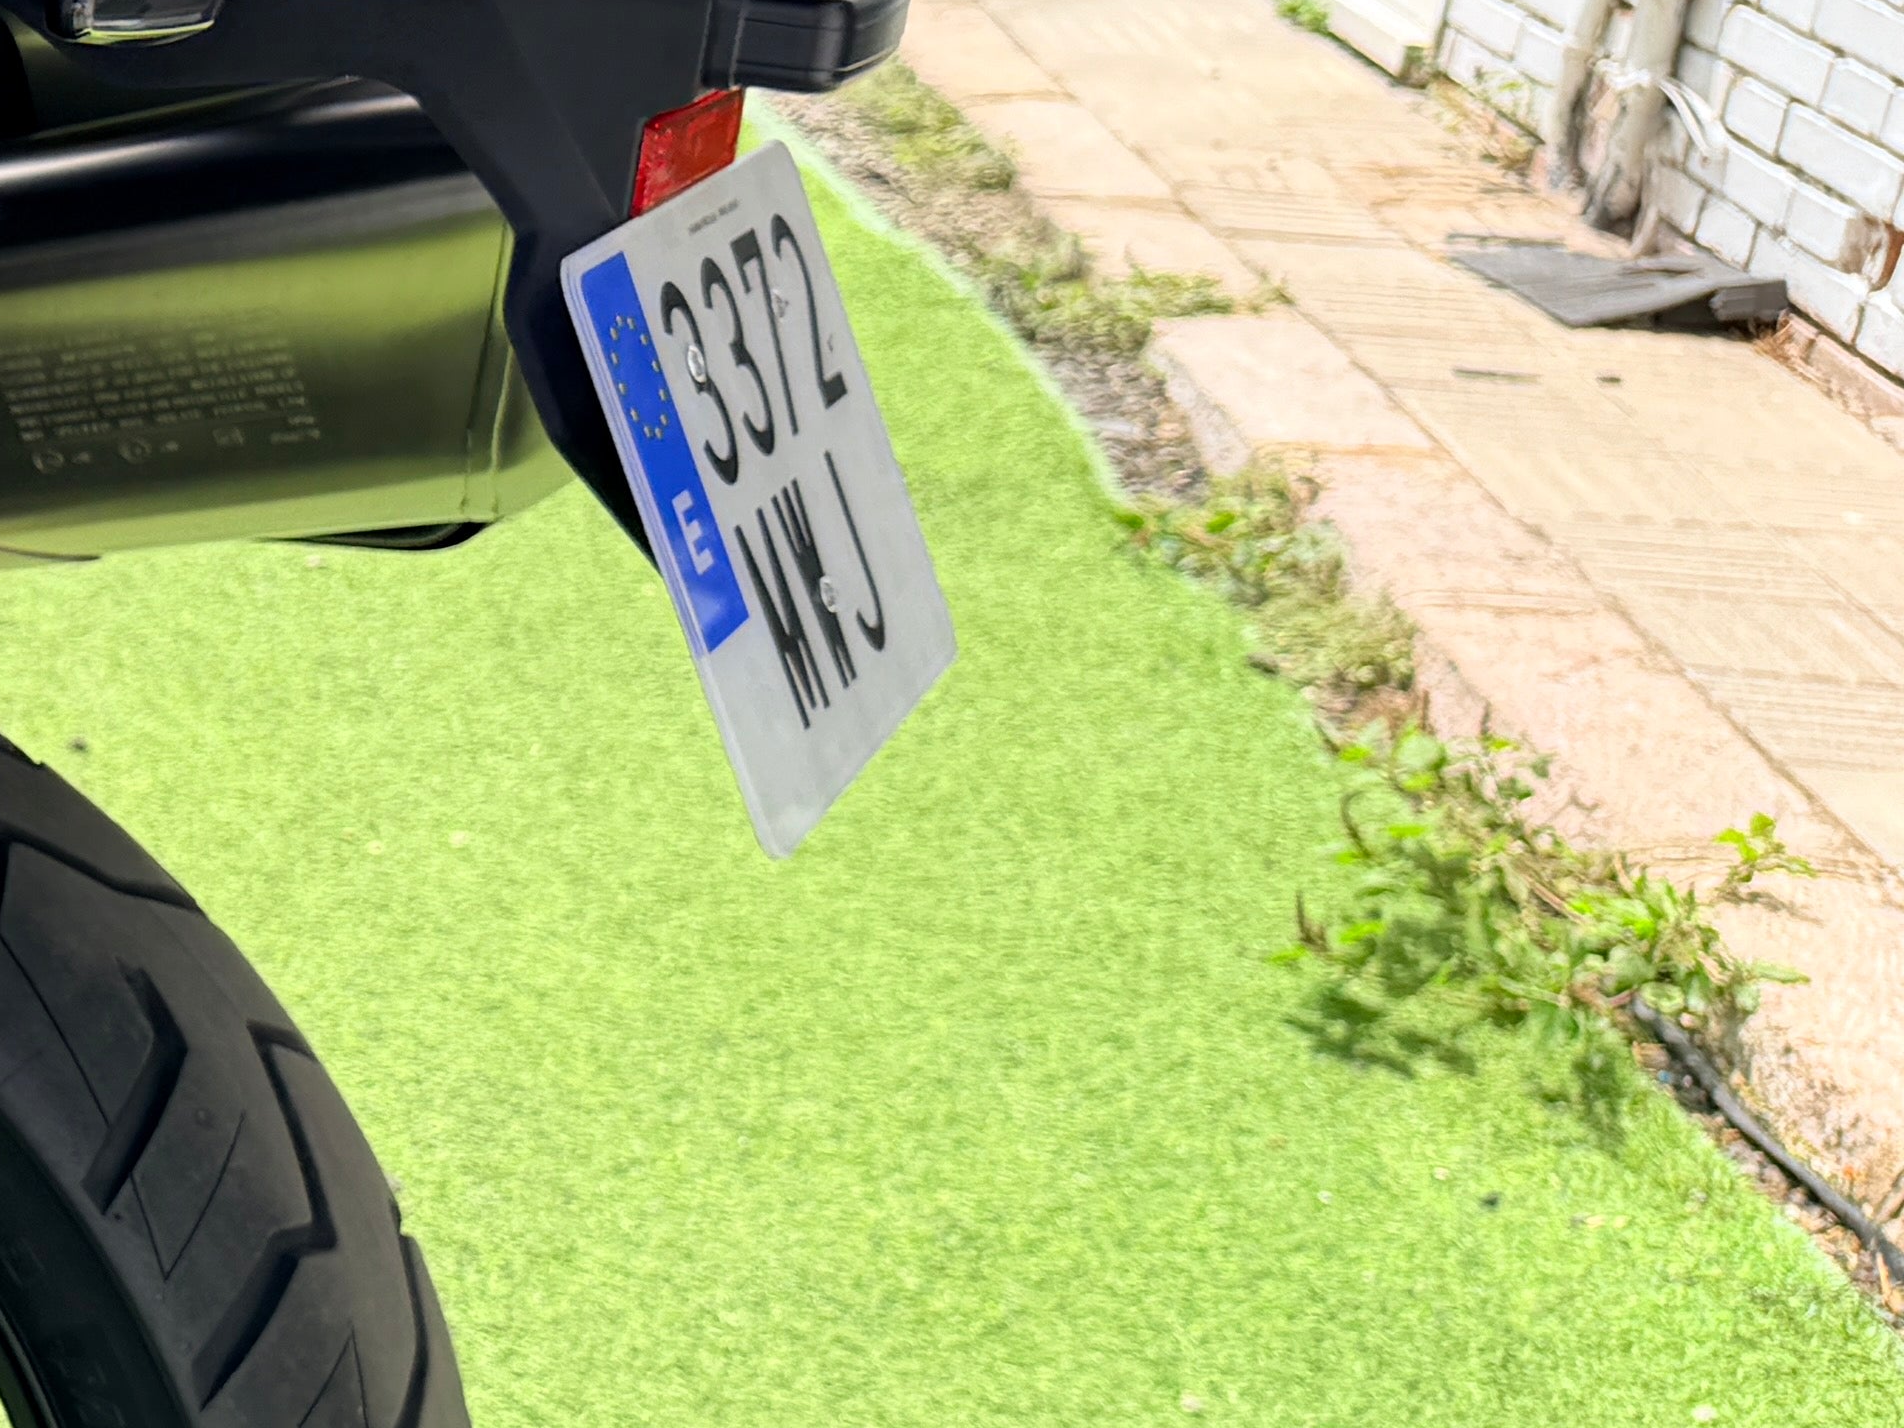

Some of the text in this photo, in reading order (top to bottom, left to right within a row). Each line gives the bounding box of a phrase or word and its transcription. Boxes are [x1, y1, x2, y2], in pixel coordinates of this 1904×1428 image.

[660, 212, 848, 486] 3372
[671, 489, 714, 576] E
[734, 450, 885, 730] MWJ
